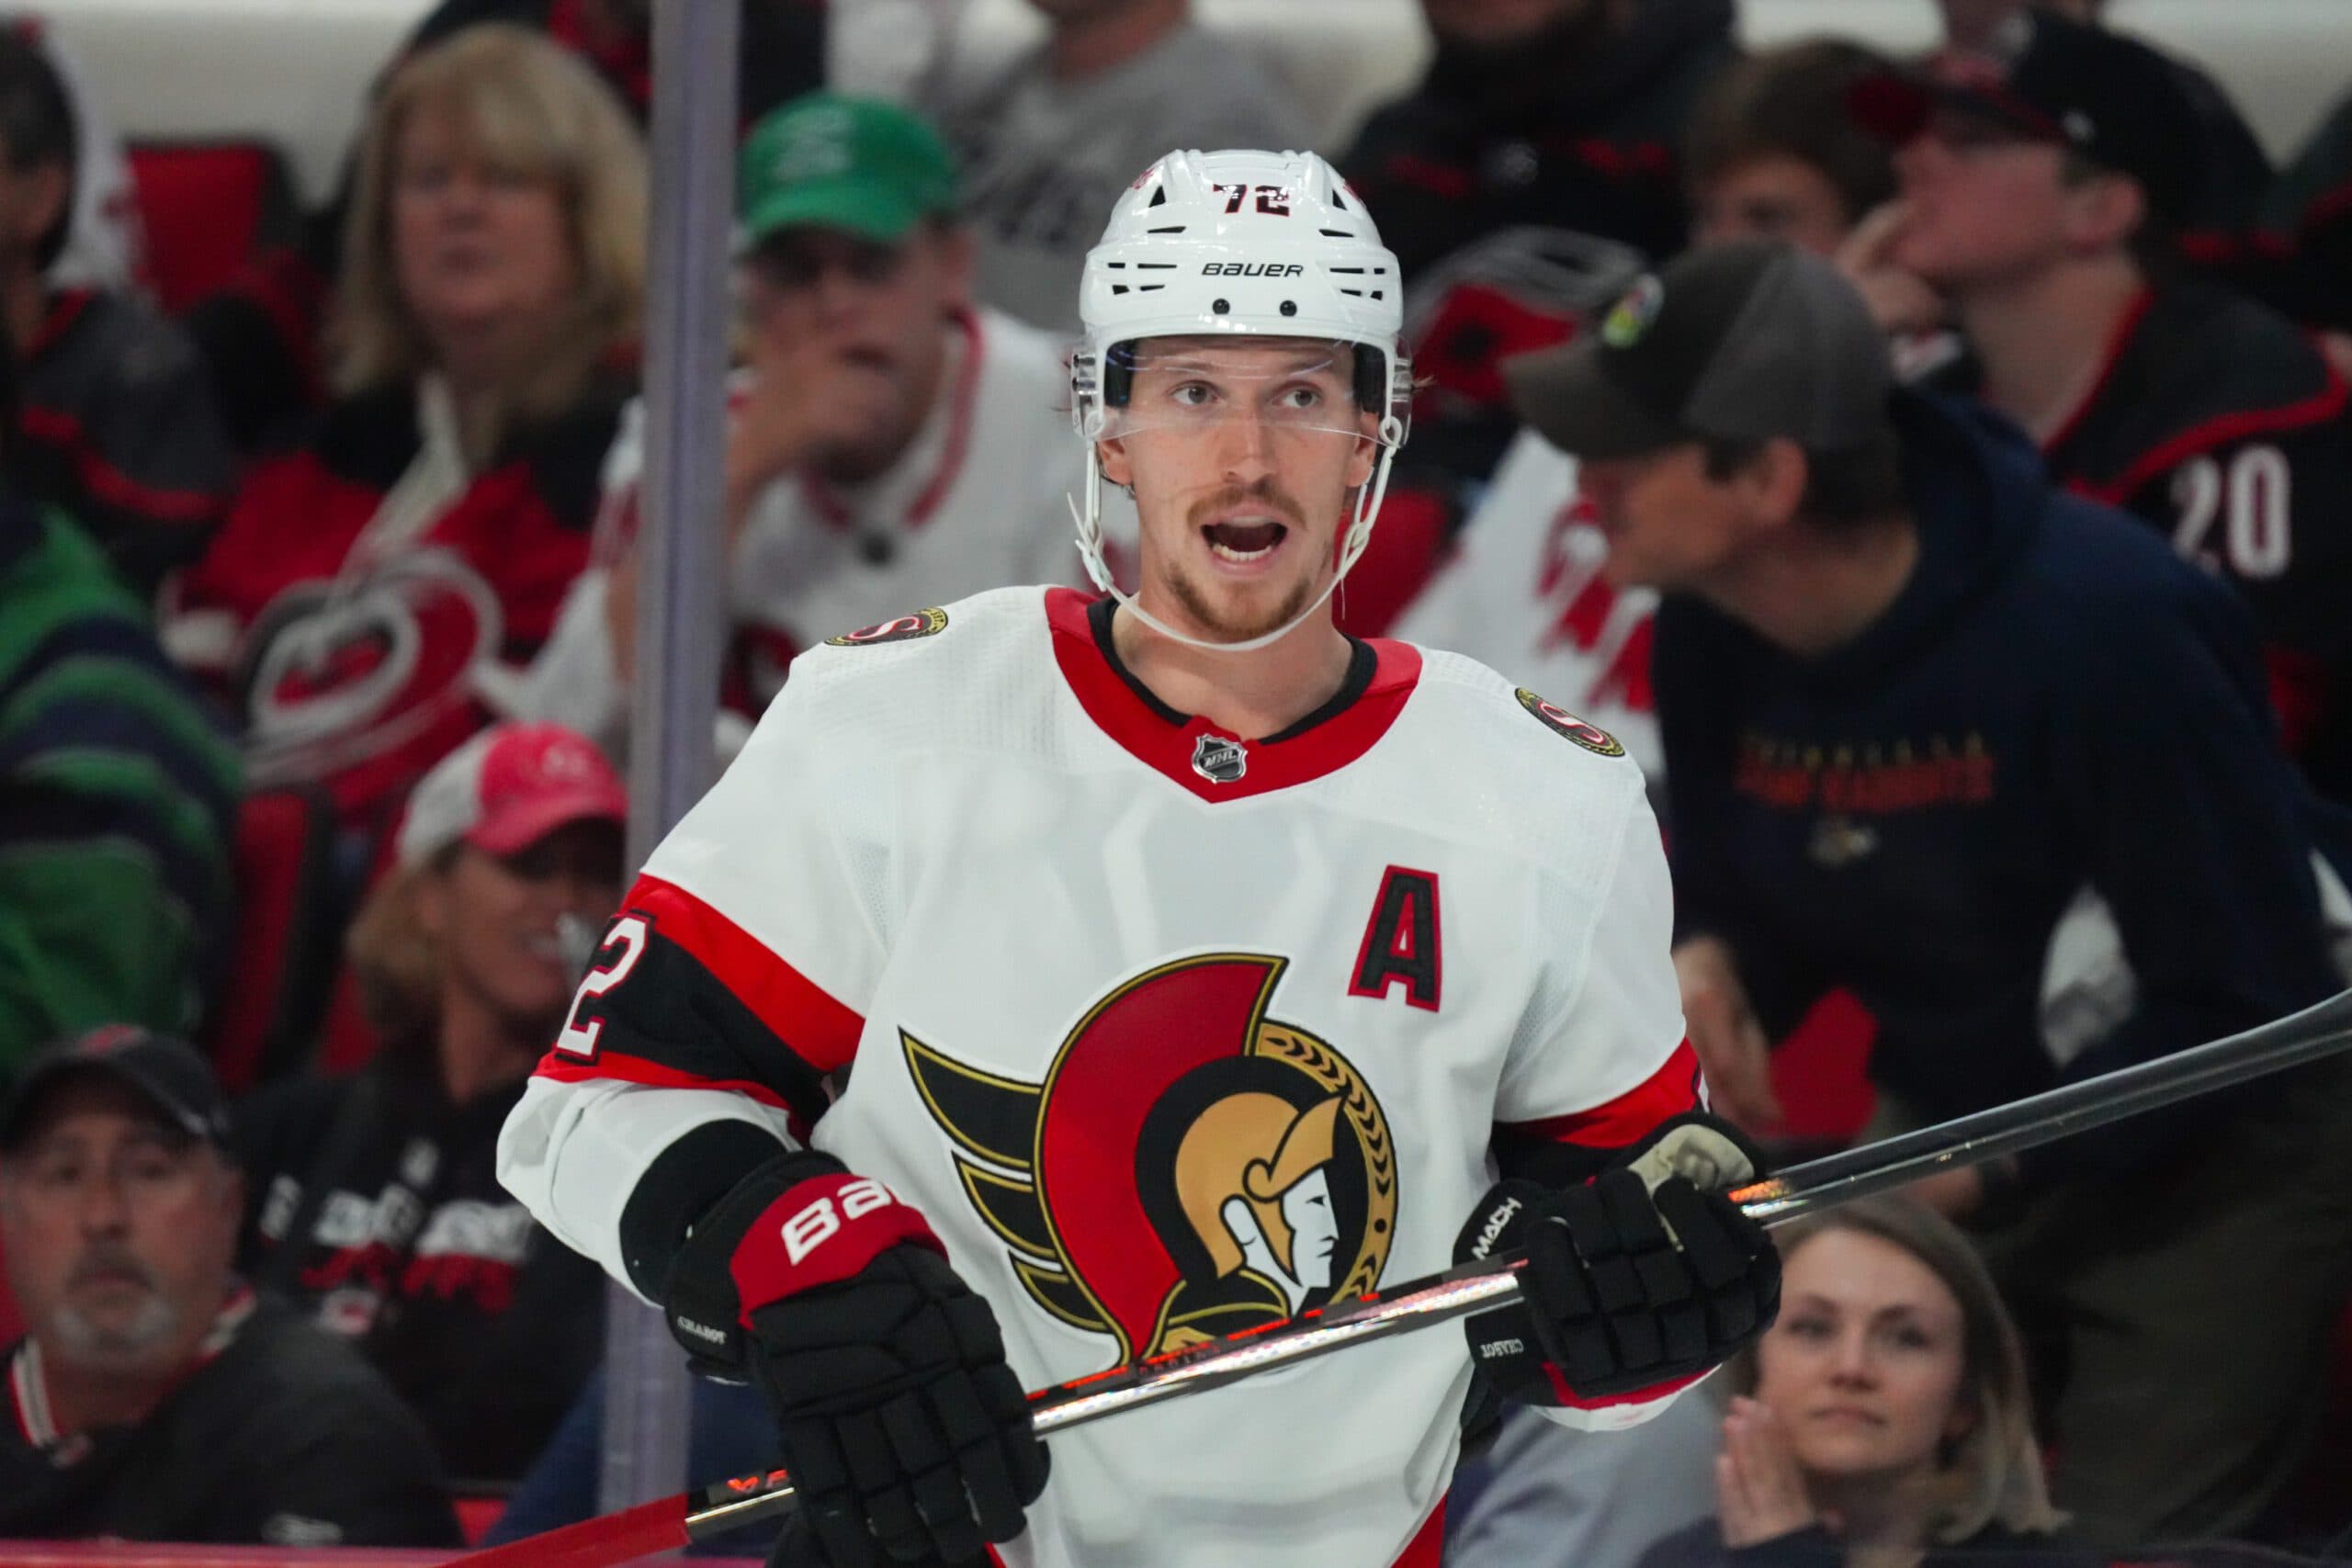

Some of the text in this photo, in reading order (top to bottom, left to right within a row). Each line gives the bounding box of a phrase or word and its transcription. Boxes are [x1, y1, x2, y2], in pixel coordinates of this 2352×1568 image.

[1213, 184, 1290, 217] 72
[2168, 450, 2291, 575] 20
[1204, 750, 1238, 768] NHL
[1347, 864, 1442, 1013] A
[1472, 1197, 1522, 1261] MACH
[1481, 1338, 1524, 1359] CHABOT
